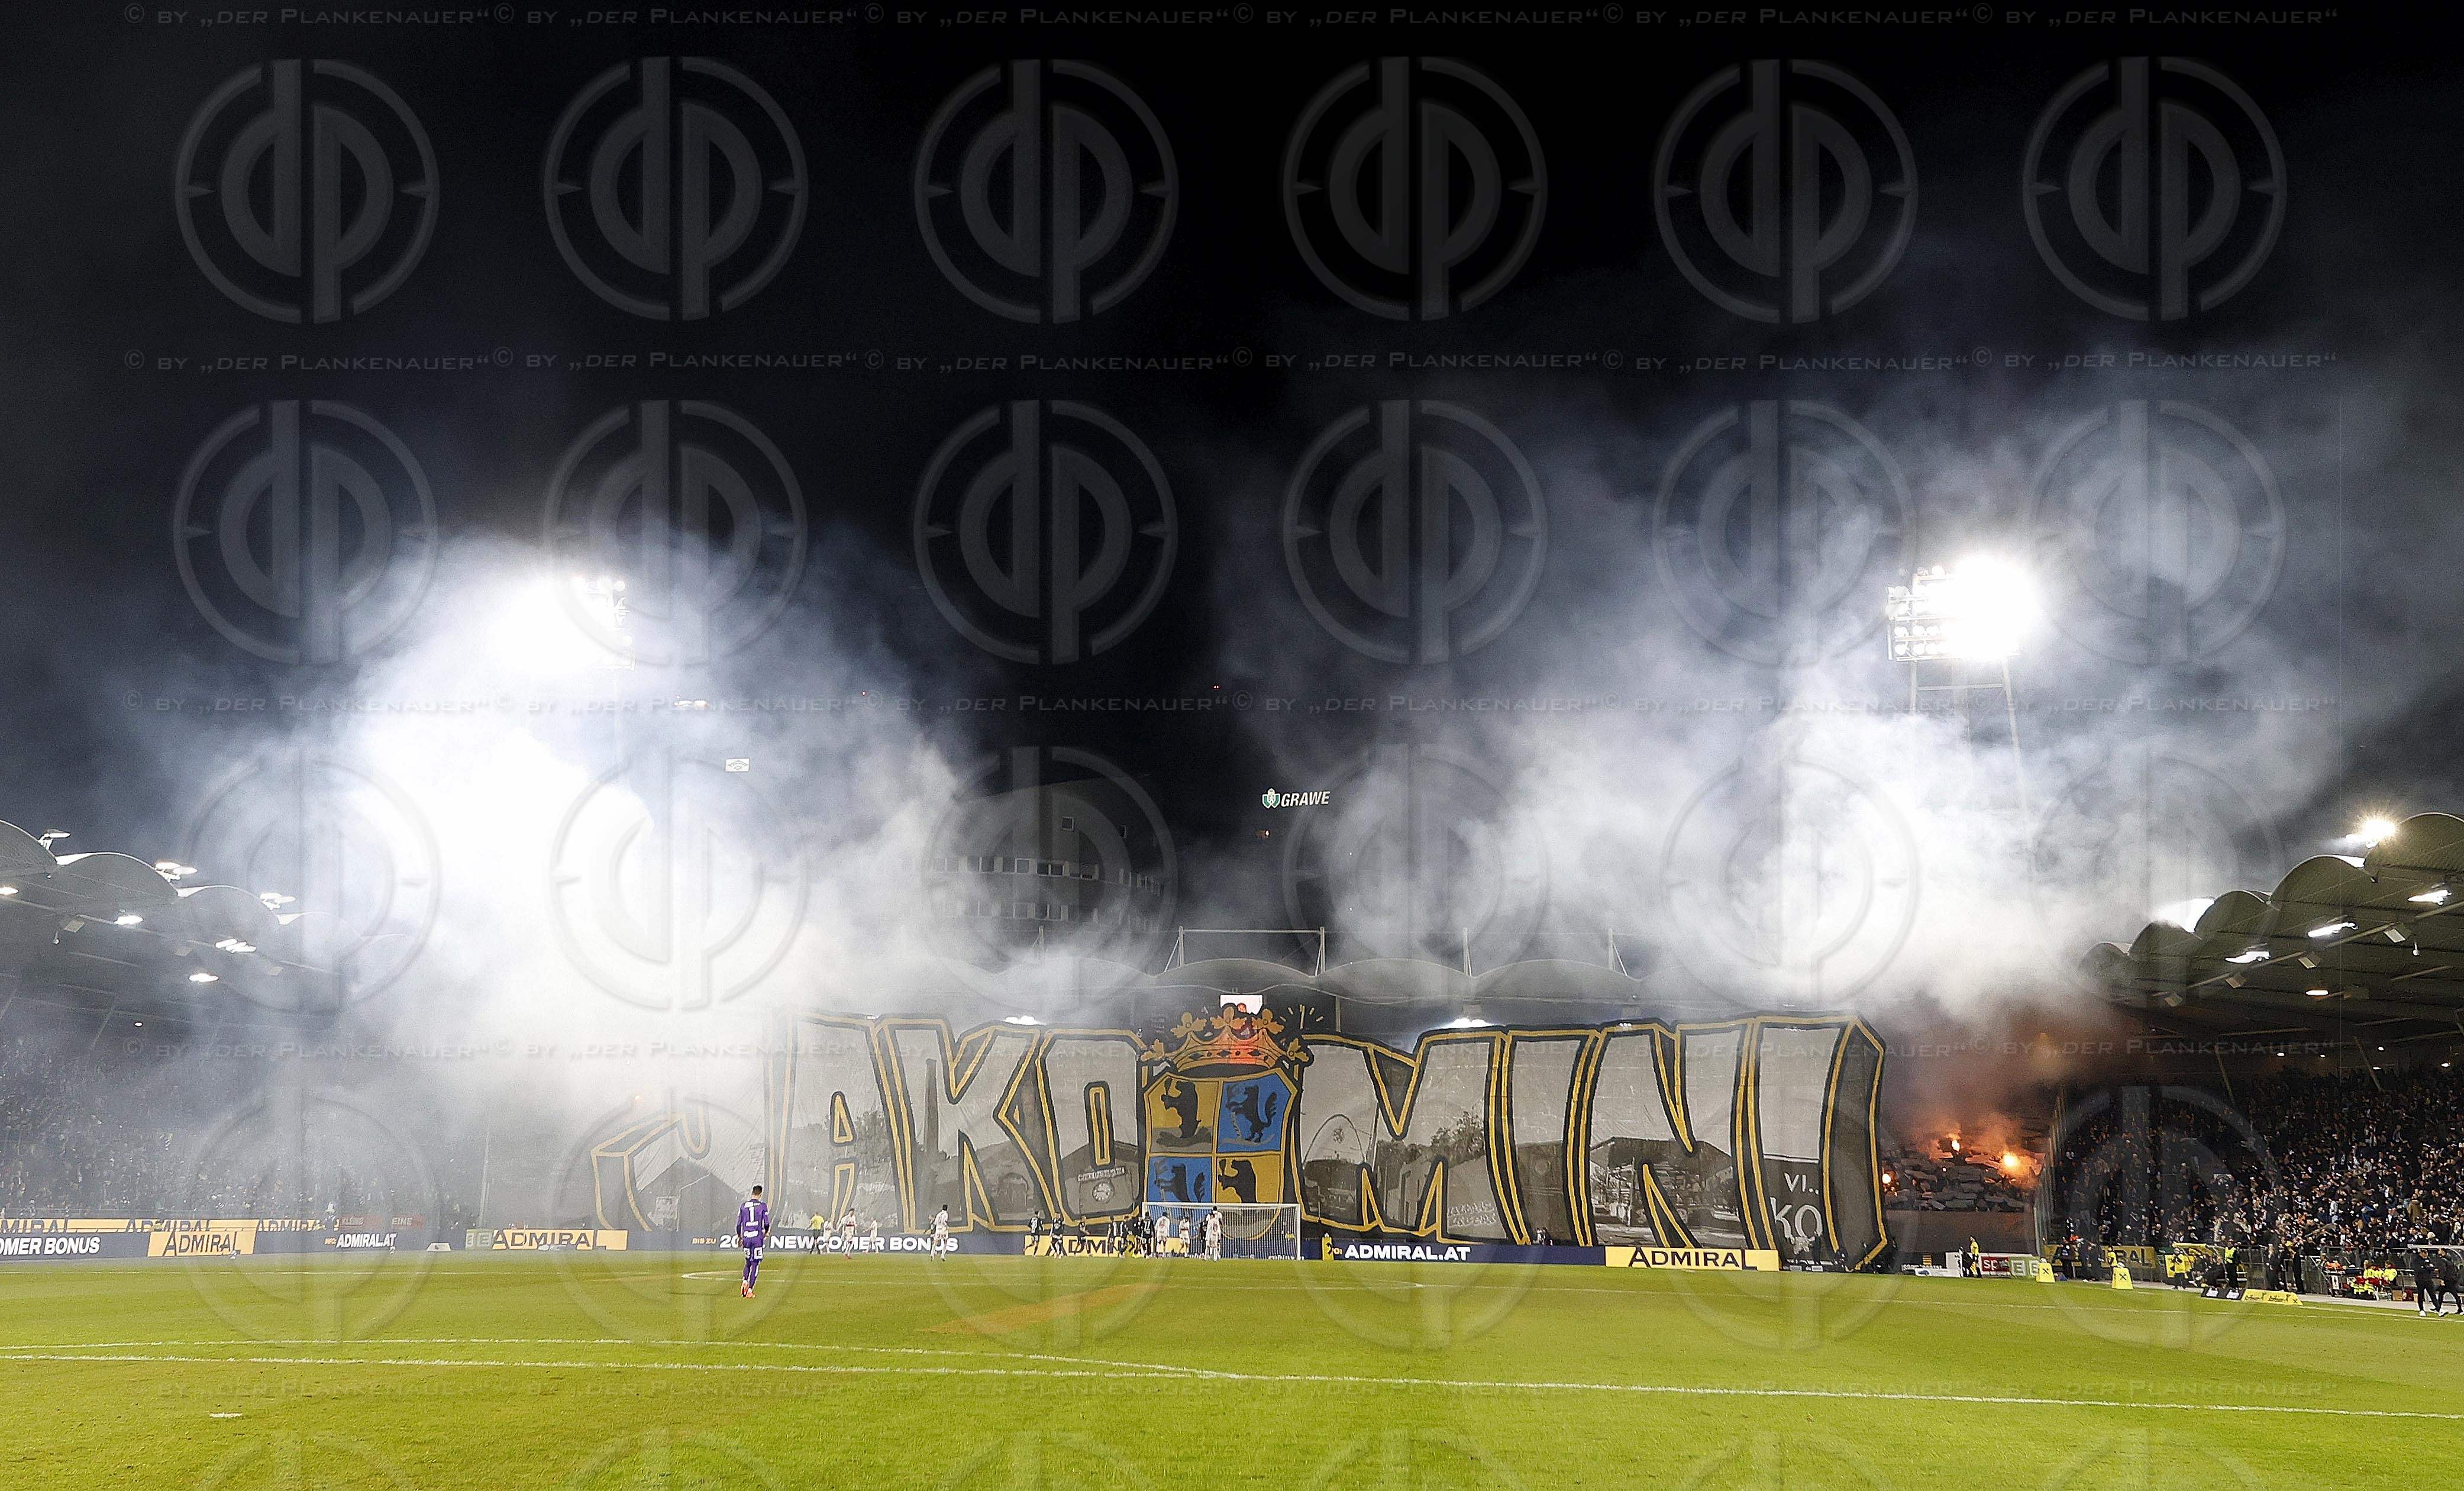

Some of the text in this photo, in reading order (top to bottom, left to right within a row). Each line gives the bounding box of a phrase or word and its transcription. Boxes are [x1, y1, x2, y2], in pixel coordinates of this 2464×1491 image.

[1281, 791, 1331, 807] GRAWE
[748, 1206, 755, 1223] 1
[44, 1237, 101, 1255] BONUS
[162, 1230, 241, 1257] ADMIRAL
[336, 1233, 398, 1248] ADMIRAL.AT
[492, 1228, 607, 1251] ADMIRAL
[1344, 1244, 1471, 1261] ADMIRAL.AT
[1628, 1247, 1758, 1271] ADMIRAL
